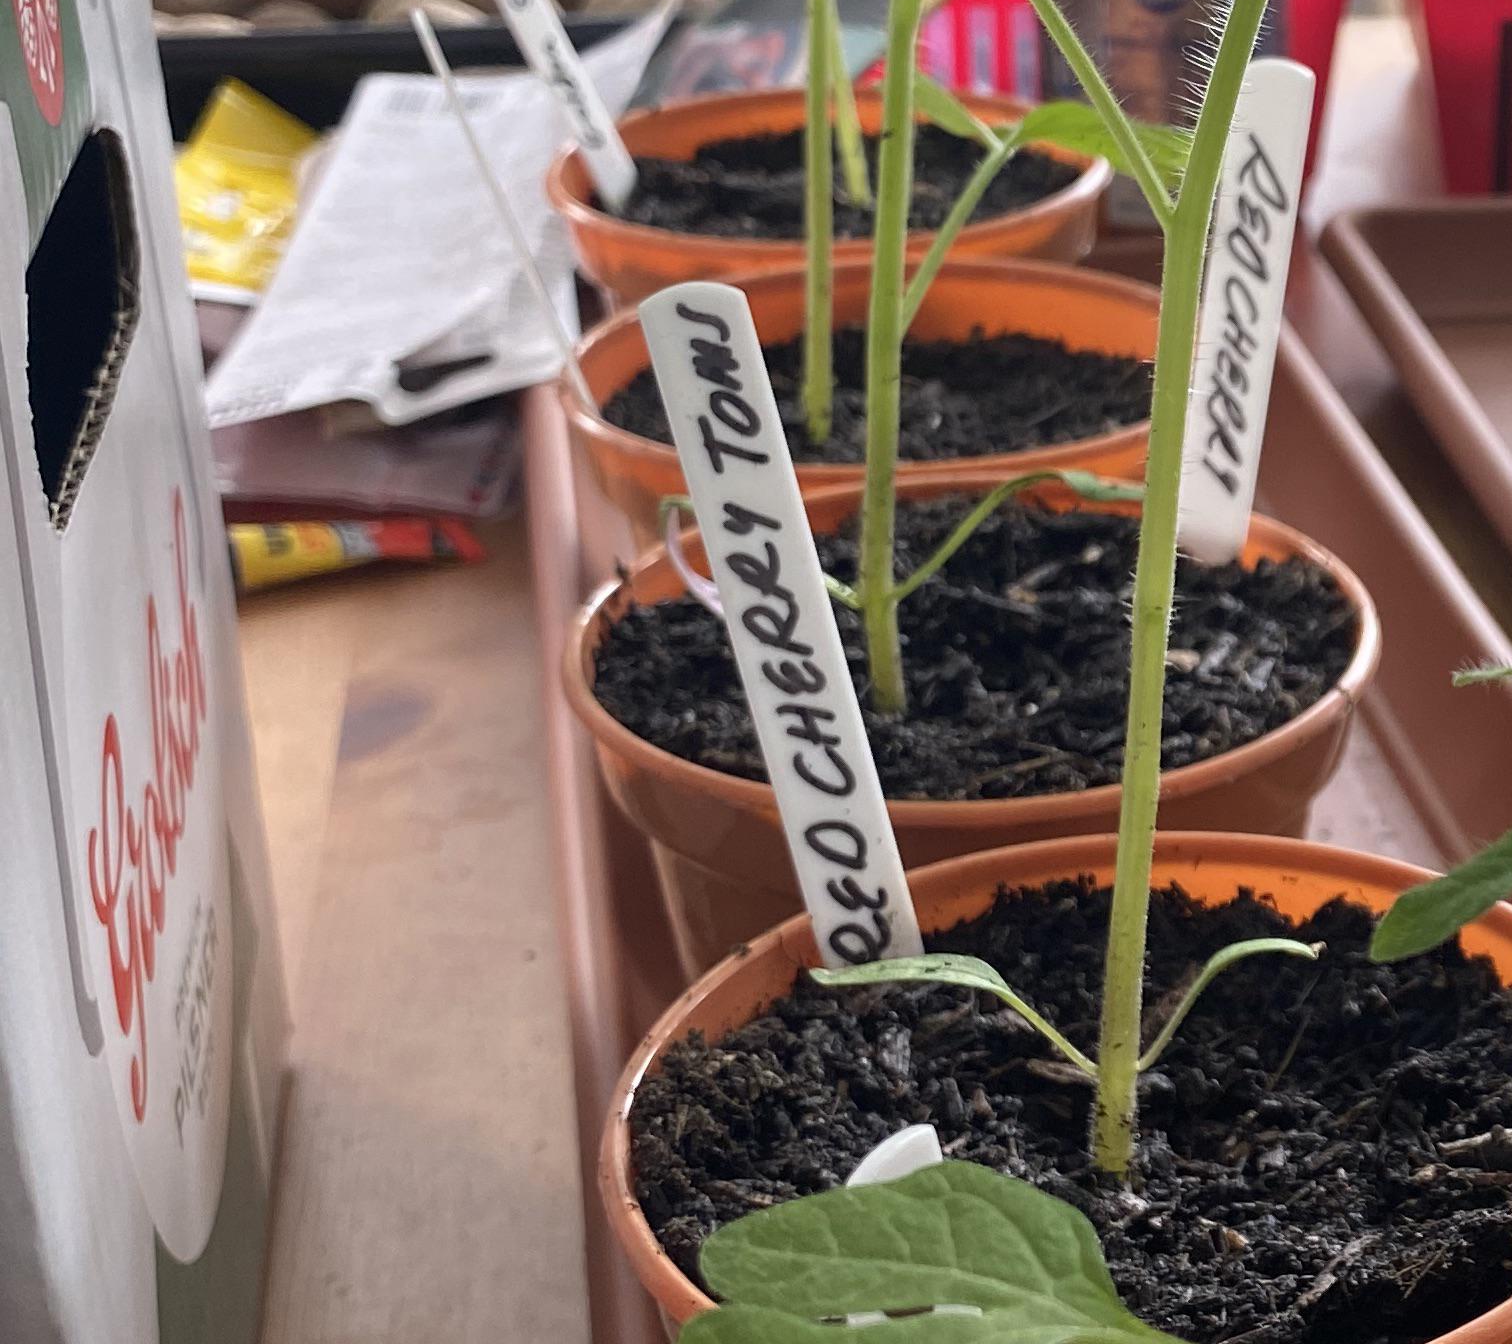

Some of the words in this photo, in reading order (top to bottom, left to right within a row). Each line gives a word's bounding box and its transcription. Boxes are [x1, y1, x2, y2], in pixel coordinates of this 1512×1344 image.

[1226, 132, 1289, 283] RED
[675, 301, 769, 475] TOMS
[1202, 274, 1260, 498] CHERRY
[721, 501, 859, 799] CHERRY
[88, 483, 207, 1126] Grolsch
[804, 819, 892, 965] RED
[174, 902, 219, 1151] PILSNER
